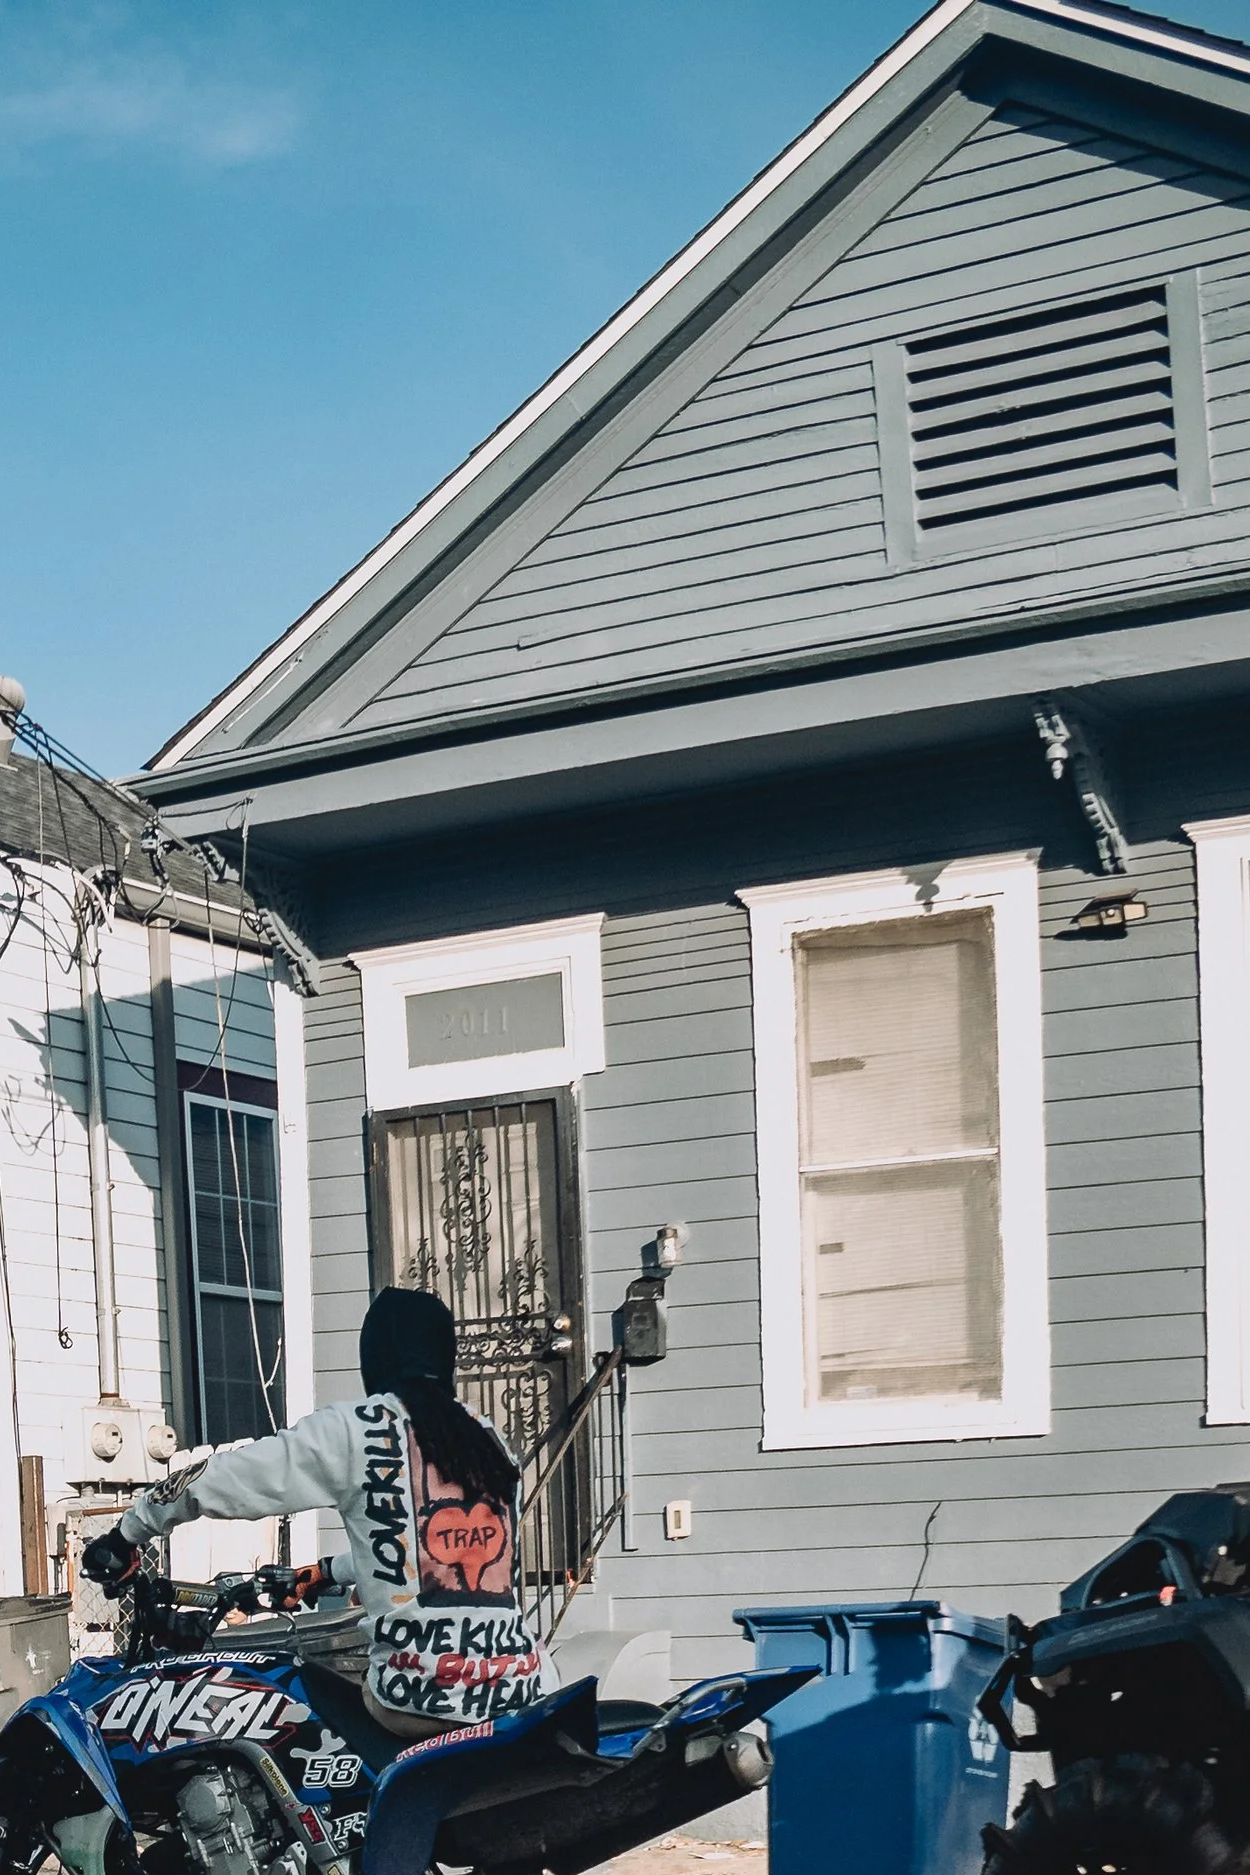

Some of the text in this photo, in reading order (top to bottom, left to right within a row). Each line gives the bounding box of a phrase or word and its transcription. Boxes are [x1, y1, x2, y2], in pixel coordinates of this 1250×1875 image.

[439, 1005, 508, 1041] 2011
[436, 1525, 497, 1550] TRAP
[374, 1615, 455, 1656] LOVE
[435, 1653, 517, 1687] BUT
[377, 1664, 456, 1714] LOVE
[303, 1755, 362, 1788] 58
